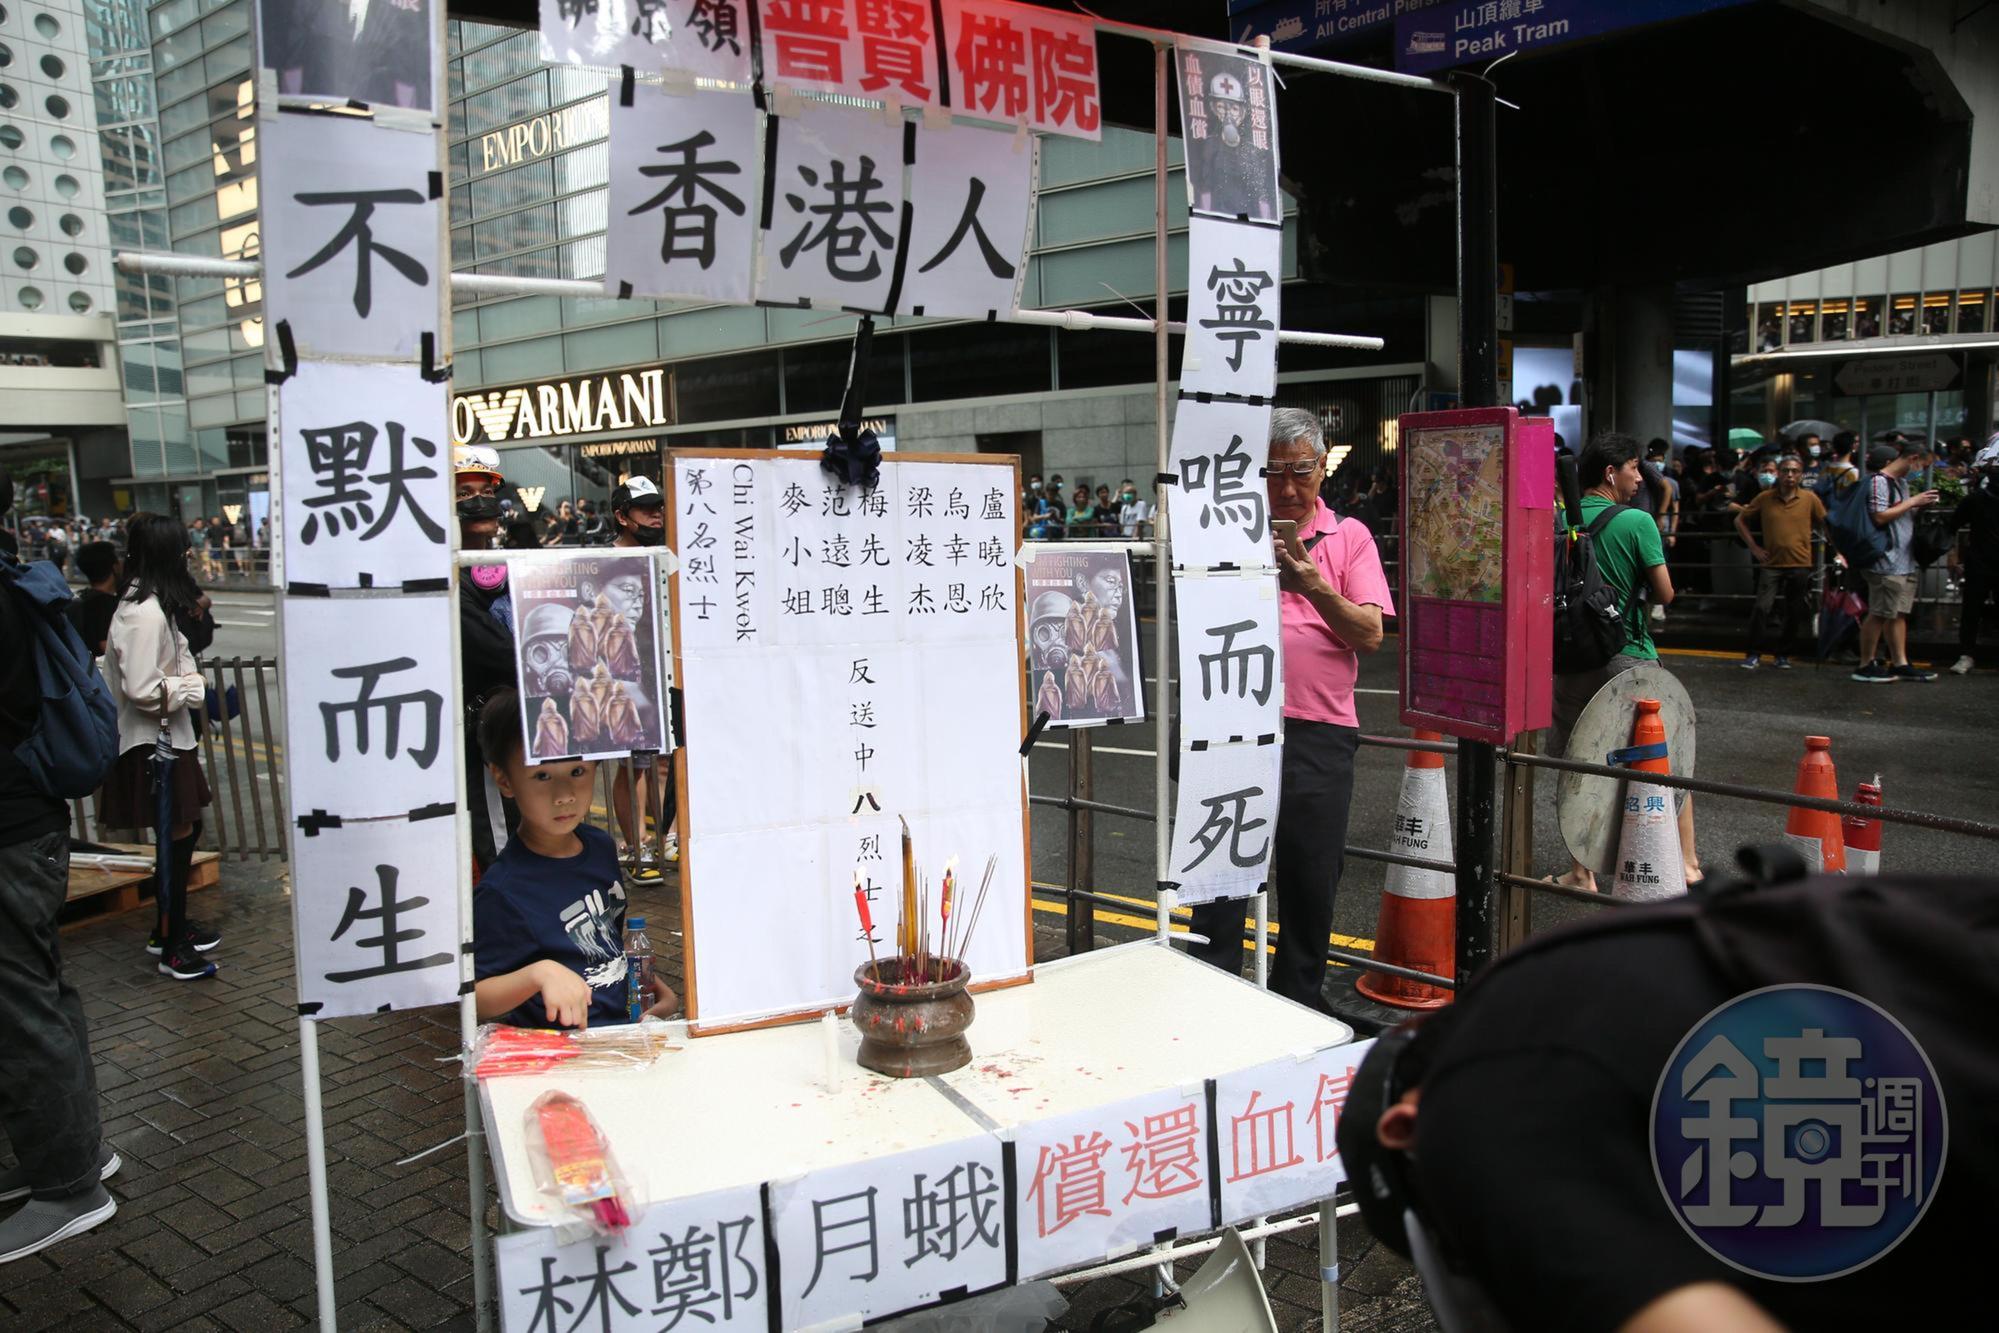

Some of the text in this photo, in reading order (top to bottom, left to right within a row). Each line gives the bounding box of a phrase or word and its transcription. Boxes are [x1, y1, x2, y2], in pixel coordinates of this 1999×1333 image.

[763, 0, 1100, 132] 普賢佛院
[1315, 21, 1335, 40] All
[1338, 4, 1391, 30] Central
[1455, 18, 1569, 59] Peak Tram
[627, 130, 1016, 283] 香港人
[513, 368, 667, 439] ARMANI
[286, 188, 456, 984] 不默而生
[733, 464, 757, 643] Chi Wai Kwok
[779, 482, 816, 616] 麥小姐
[821, 484, 854, 616] 范遠聰
[857, 487, 891, 616] 梅先生
[906, 486, 936, 615] 梁凌杰
[943, 486, 973, 614] 烏幸恩
[978, 486, 1008, 612] 盧曉欣
[1055, 567, 1073, 578] YOU
[1401, 836, 1428, 849] FUNG
[1637, 873, 1659, 884] FUNG
